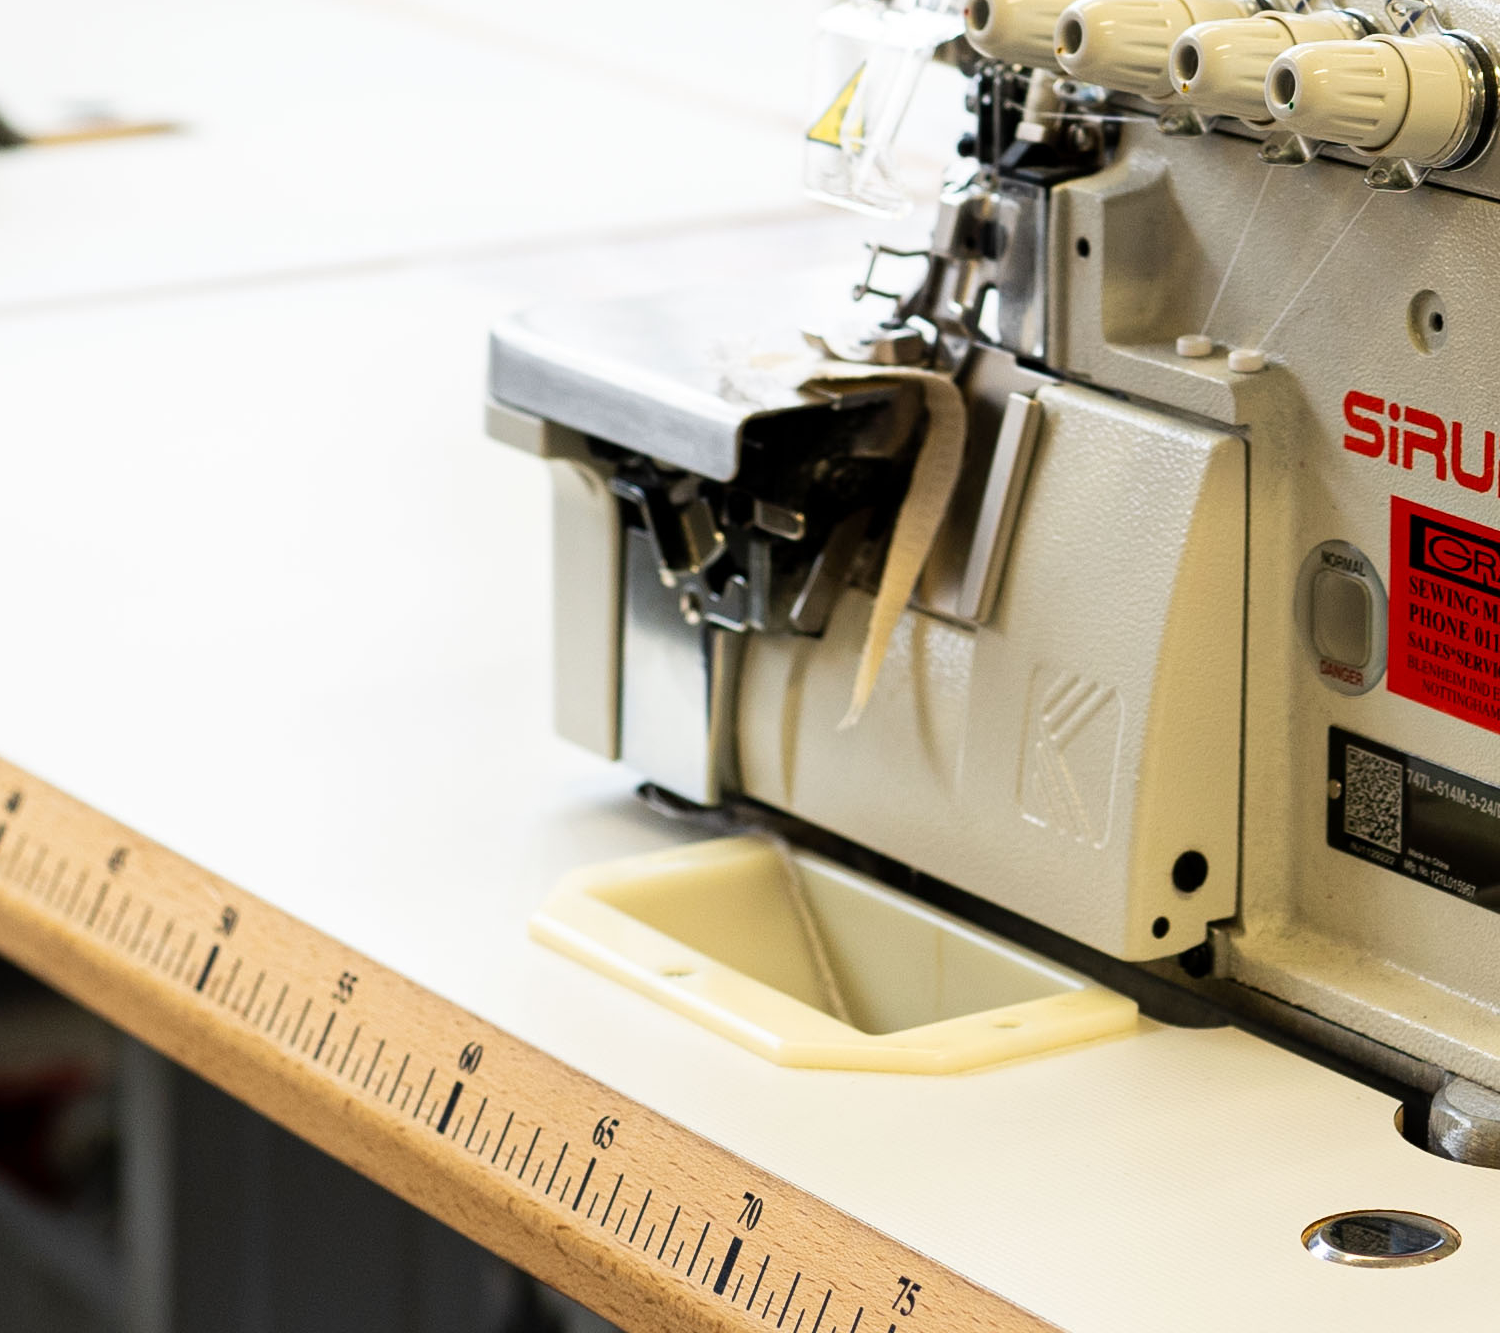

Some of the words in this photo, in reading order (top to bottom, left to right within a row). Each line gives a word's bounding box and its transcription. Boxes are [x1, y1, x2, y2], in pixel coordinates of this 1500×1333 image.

[1321, 550, 1366, 577] NORMAL
[1409, 576, 1478, 616] SEWING
[1409, 602, 1469, 641] PHONE
[1320, 660, 1364, 686] DANGER
[1407, 654, 1467, 687] BLENHEIM
[1469, 679, 1490, 698] IND
[1422, 679, 1500, 721] NOTTINGHAM
[332, 971, 358, 1004] 55
[458, 1041, 483, 1075] 60
[592, 1115, 620, 1150] 65
[737, 1191, 763, 1231] 70
[892, 1275, 923, 1317] 75
